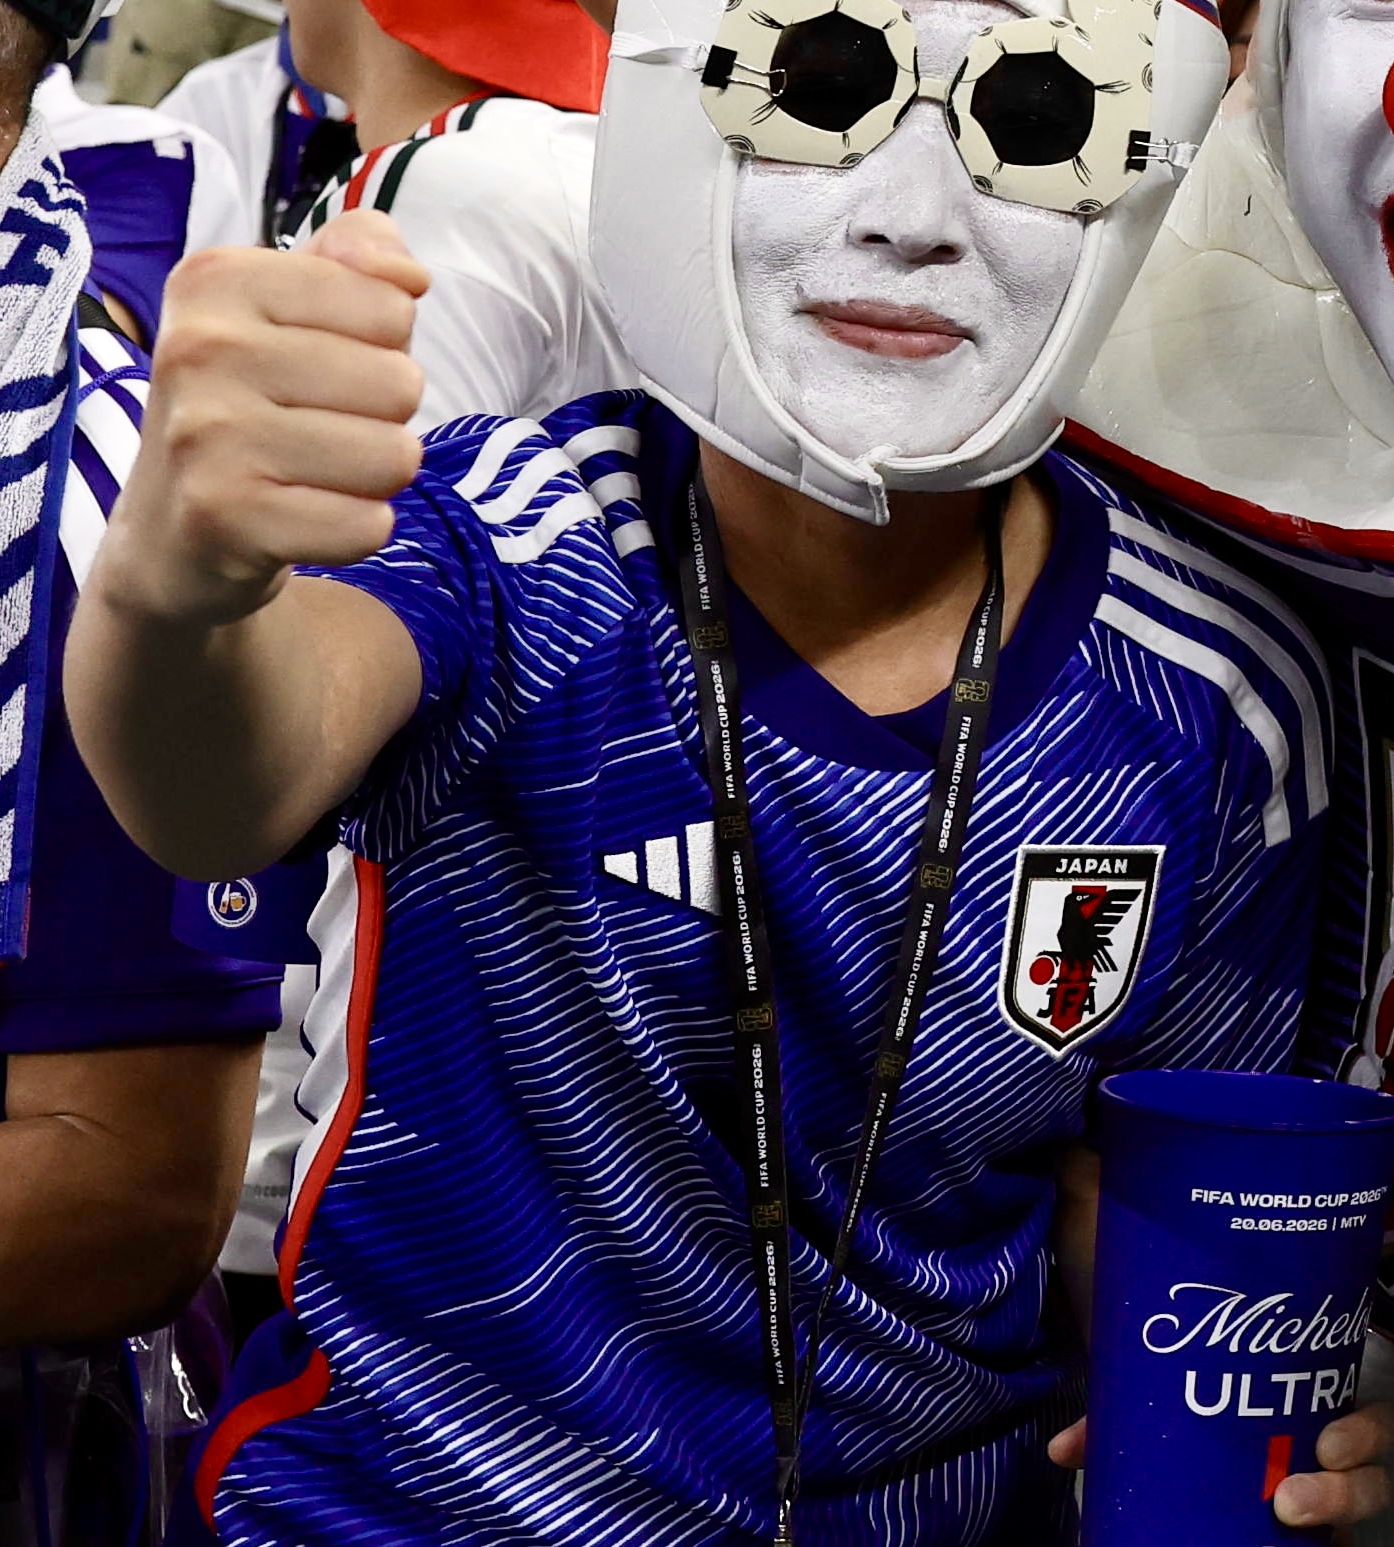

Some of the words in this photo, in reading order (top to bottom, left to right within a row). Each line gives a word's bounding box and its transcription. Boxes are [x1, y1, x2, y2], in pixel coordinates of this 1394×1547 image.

[691, 522, 702, 543] CUP
[694, 543, 707, 585] WORLD
[699, 585, 712, 611] FIFA
[718, 707, 729, 728] CUP
[959, 716, 972, 740] FIFA
[722, 730, 733, 772] WORLD
[951, 743, 967, 784] WORLD
[725, 774, 736, 799] FIFA
[946, 785, 959, 809] CUP
[1055, 858, 1129, 874] JAPAN
[737, 897, 748, 921] CUP
[921, 902, 934, 928] FIFA
[740, 922, 754, 965] WORLD
[912, 930, 928, 972] WORLD
[746, 966, 758, 992] FIFA
[906, 972, 918, 996] CUP
[1036, 984, 1098, 1019] JFA
[754, 1090, 765, 1115] CUP
[755, 1116, 768, 1160] WORLD
[759, 1161, 770, 1189] FIFA
[1191, 1188, 1235, 1206] FIFA
[1239, 1192, 1312, 1208] WORLD
[1314, 1193, 1349, 1208] CUP
[1230, 1217, 1328, 1232] 20.06.2026
[769, 1288, 778, 1313] CUP
[774, 1359, 785, 1385] FIFA
[1184, 1363, 1356, 1417] ULTRA
